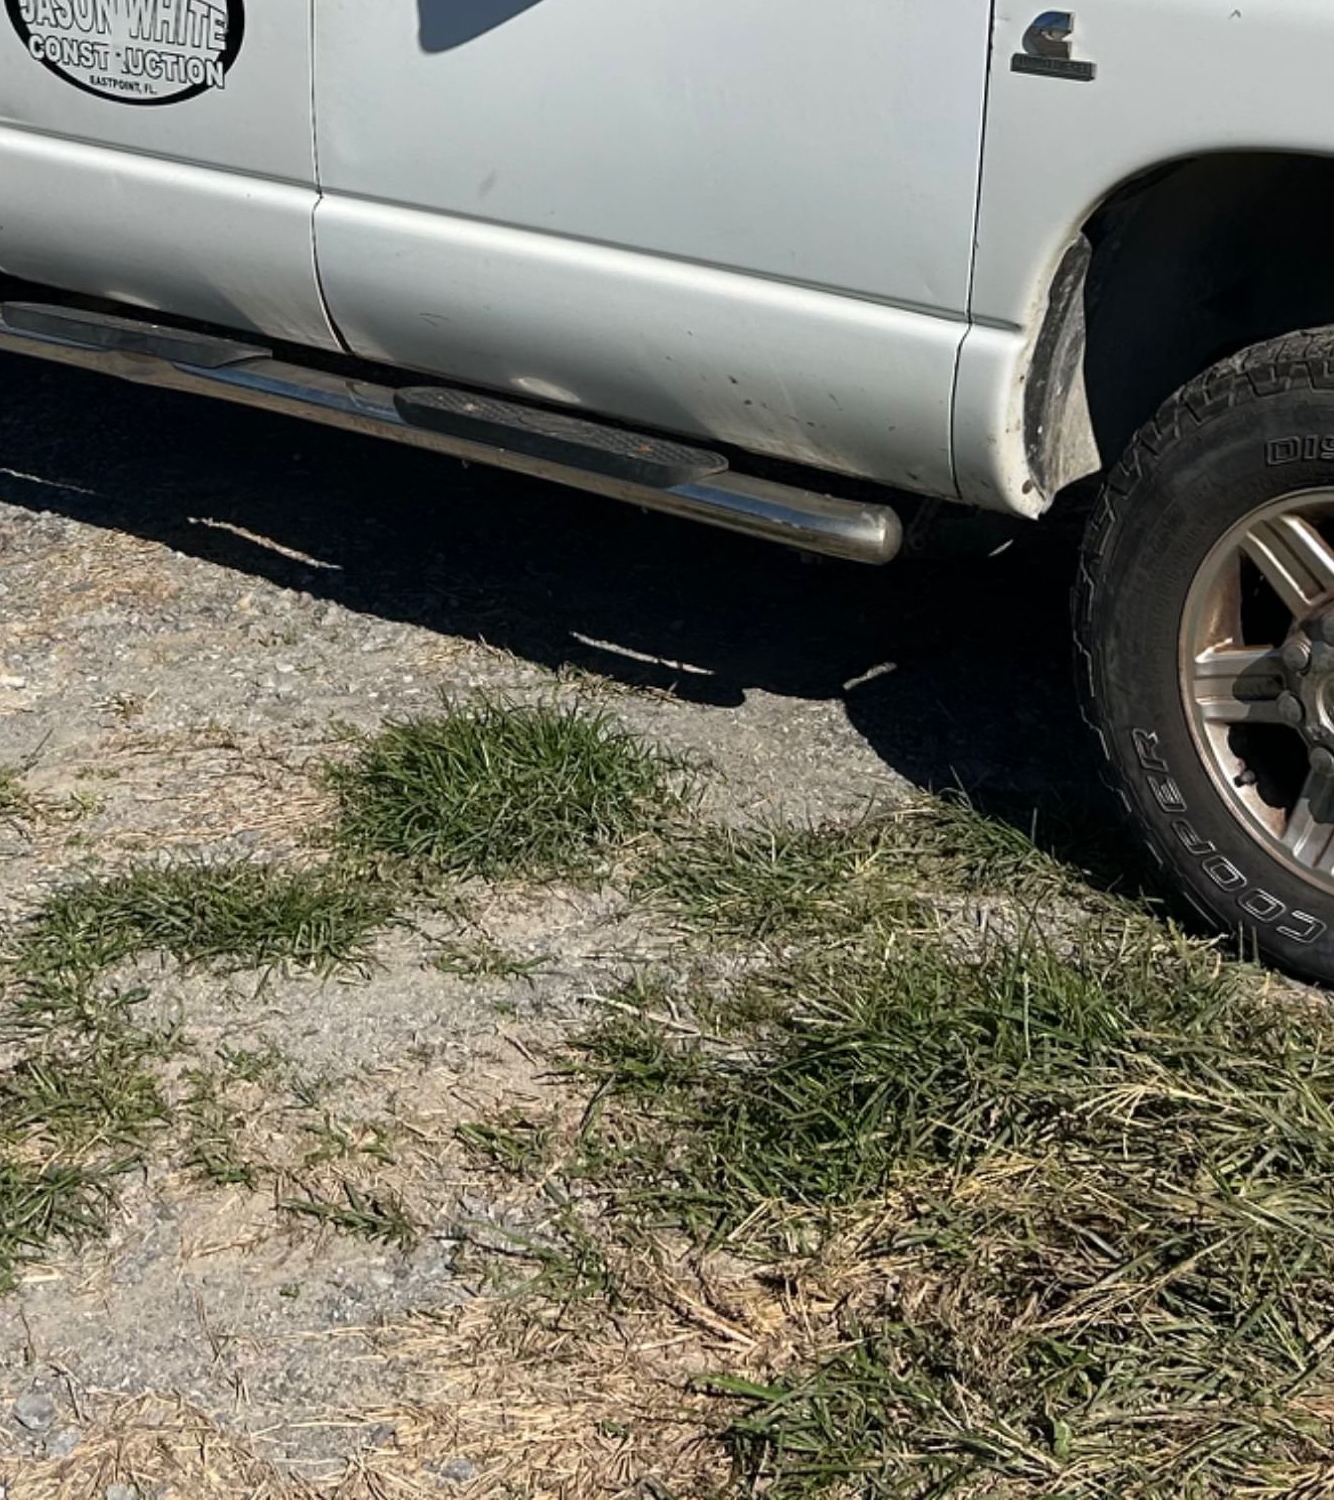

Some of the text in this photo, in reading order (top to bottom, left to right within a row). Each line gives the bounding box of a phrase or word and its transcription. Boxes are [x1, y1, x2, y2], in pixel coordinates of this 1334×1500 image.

[28, 33, 225, 88] CONSTUCTION
[89, 75, 142, 94] EASTPOINT,
[1130, 727, 1328, 944] COOPER
